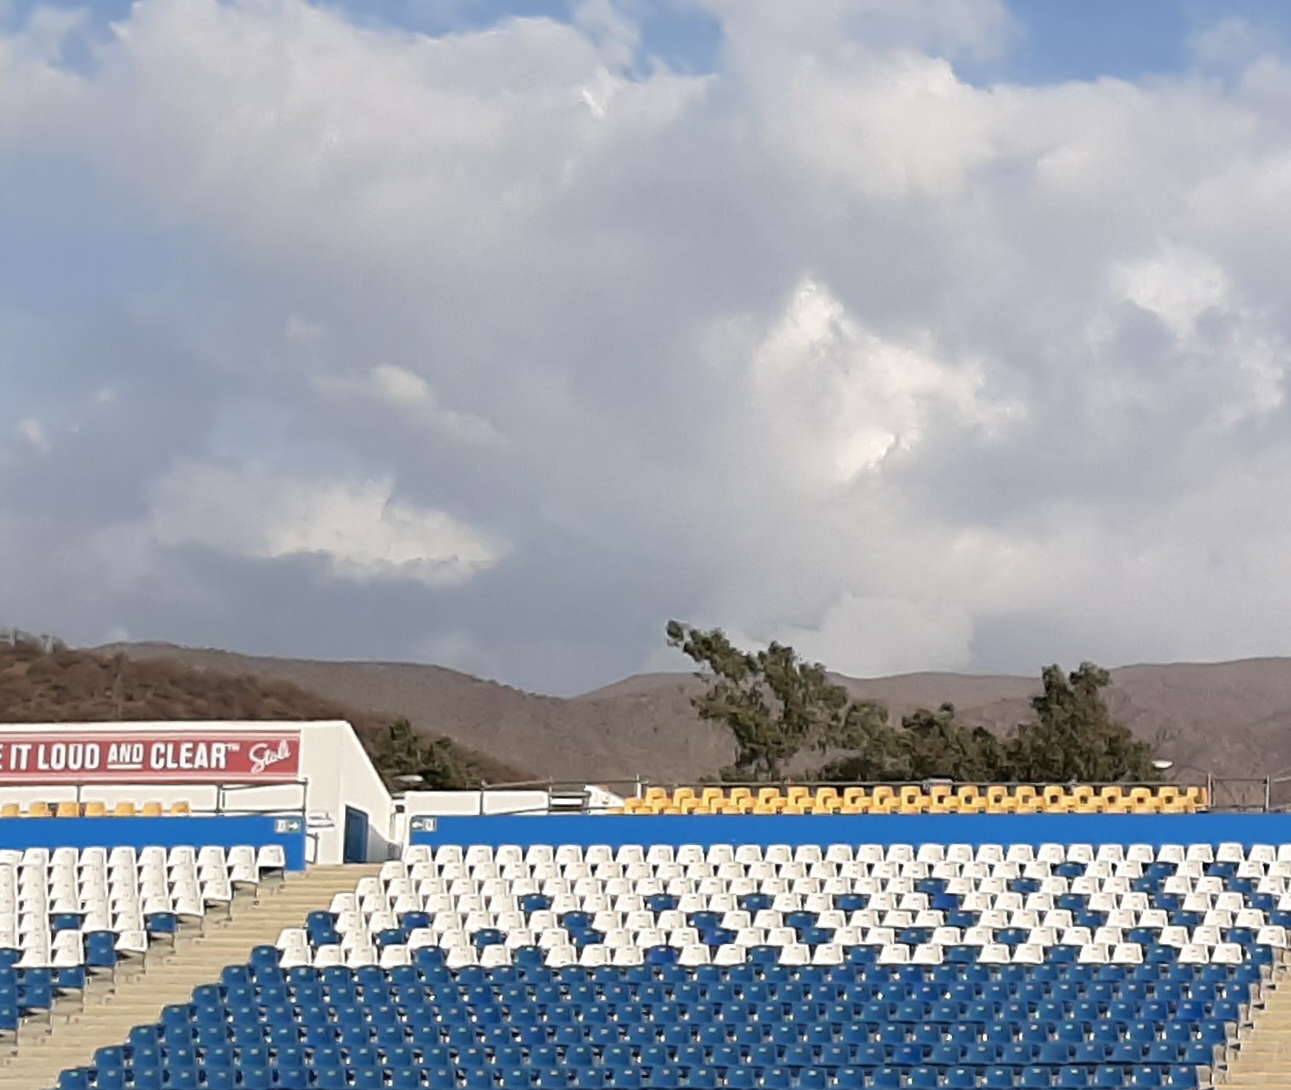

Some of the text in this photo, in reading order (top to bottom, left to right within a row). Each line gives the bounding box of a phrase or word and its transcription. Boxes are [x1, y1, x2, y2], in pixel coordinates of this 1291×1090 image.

[10, 744, 32, 770] IT
[37, 743, 100, 770] LOUD
[107, 743, 144, 765] AND
